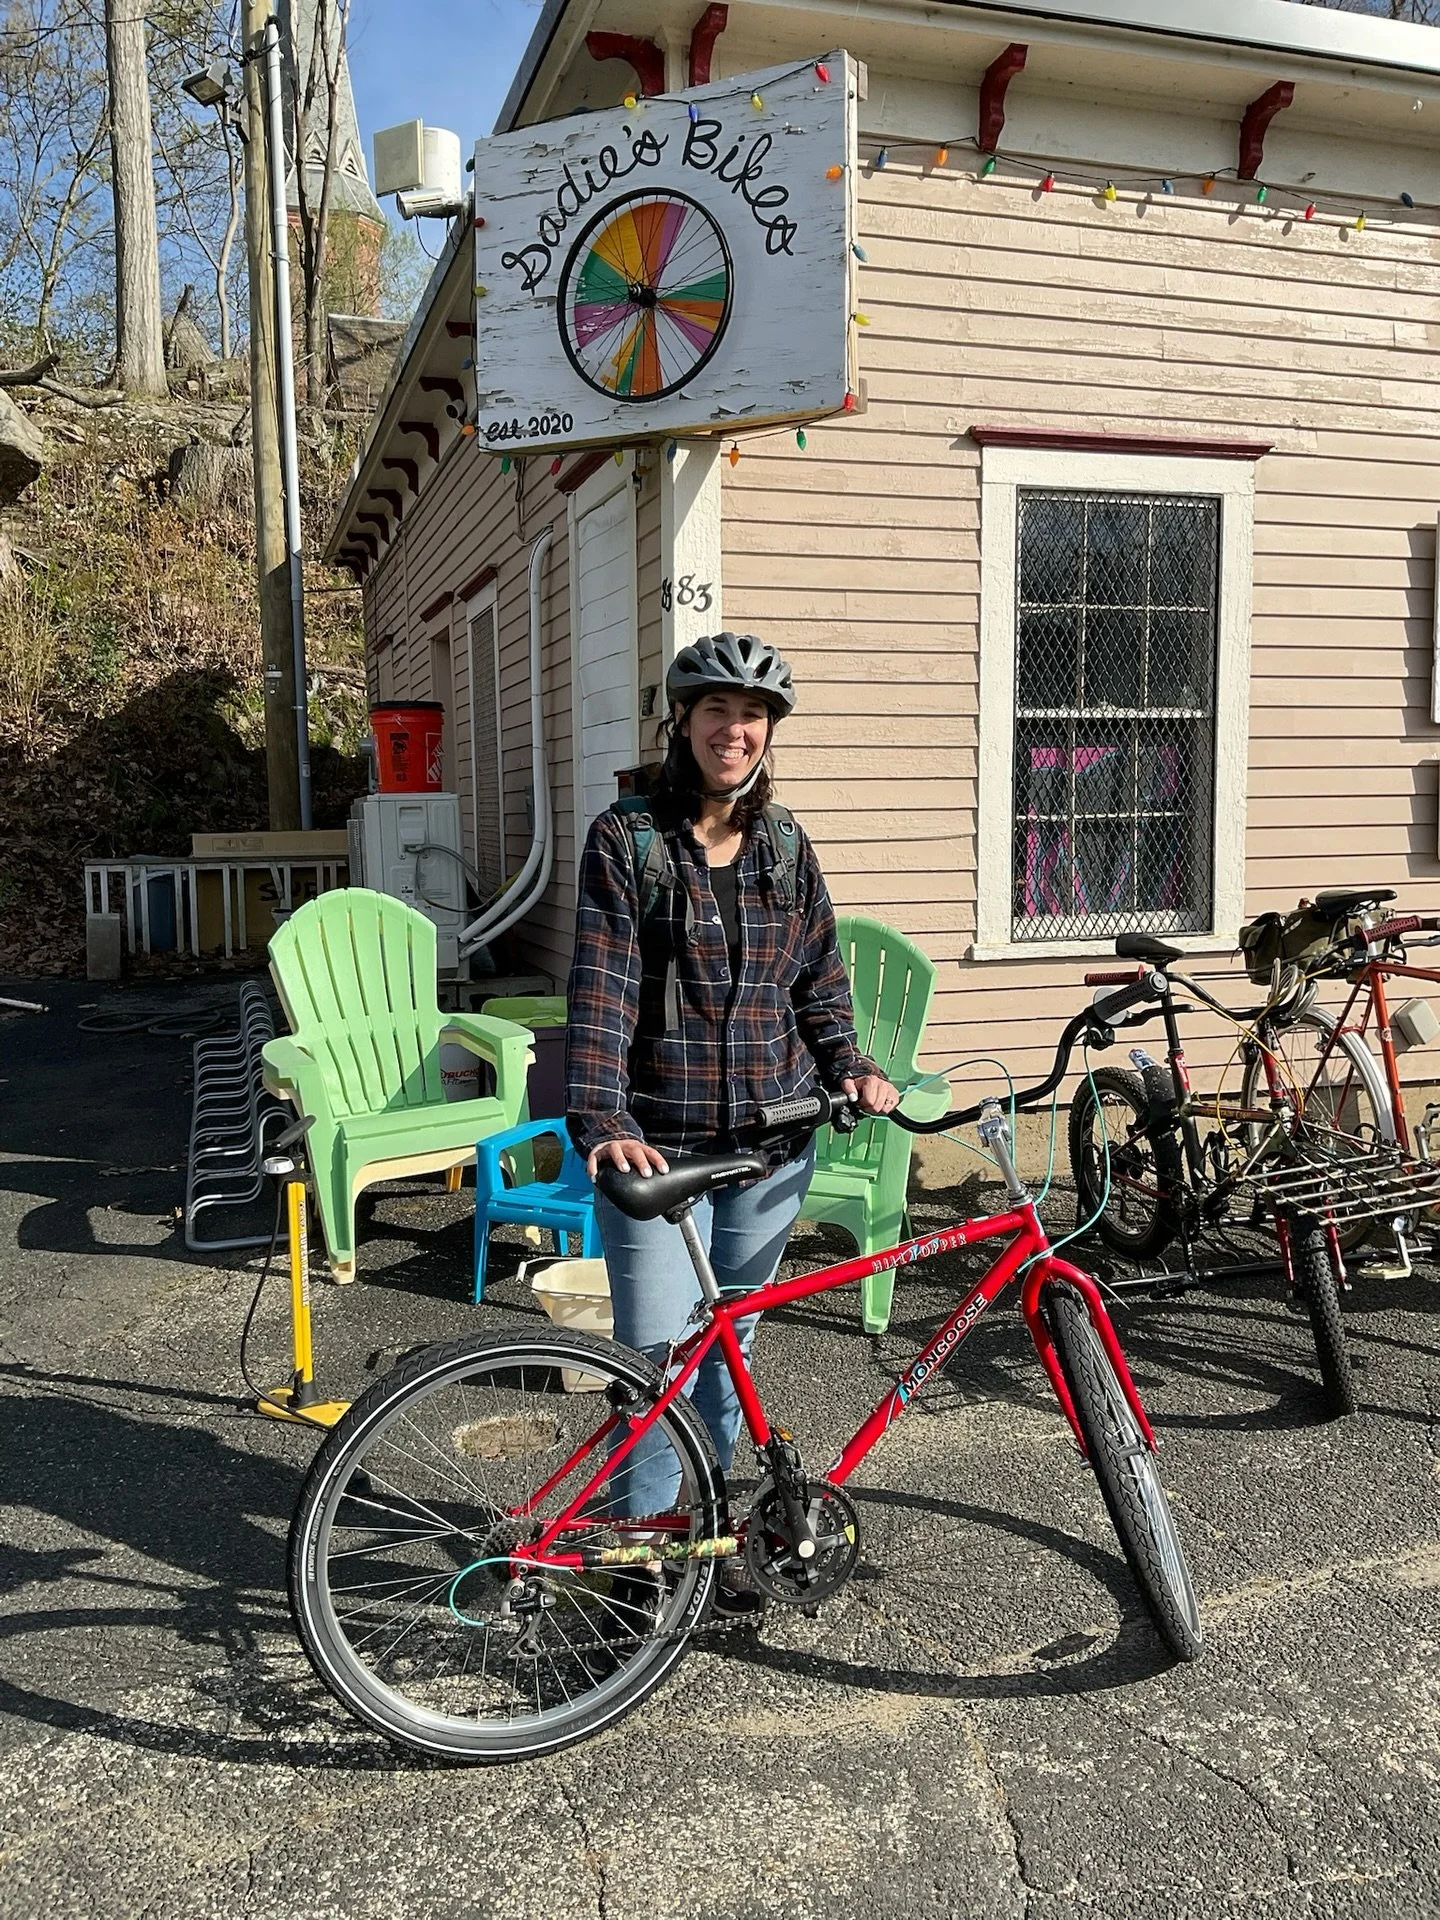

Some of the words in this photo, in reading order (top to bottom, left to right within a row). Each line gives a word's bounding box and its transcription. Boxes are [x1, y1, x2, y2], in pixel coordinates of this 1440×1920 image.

[501, 125, 669, 295] Sadie's
[681, 119, 798, 256] Bikes
[528, 413, 574, 437] 2020
[901, 1292, 988, 1397] MONGOOSE
[686, 1563, 710, 1616] ENDA
